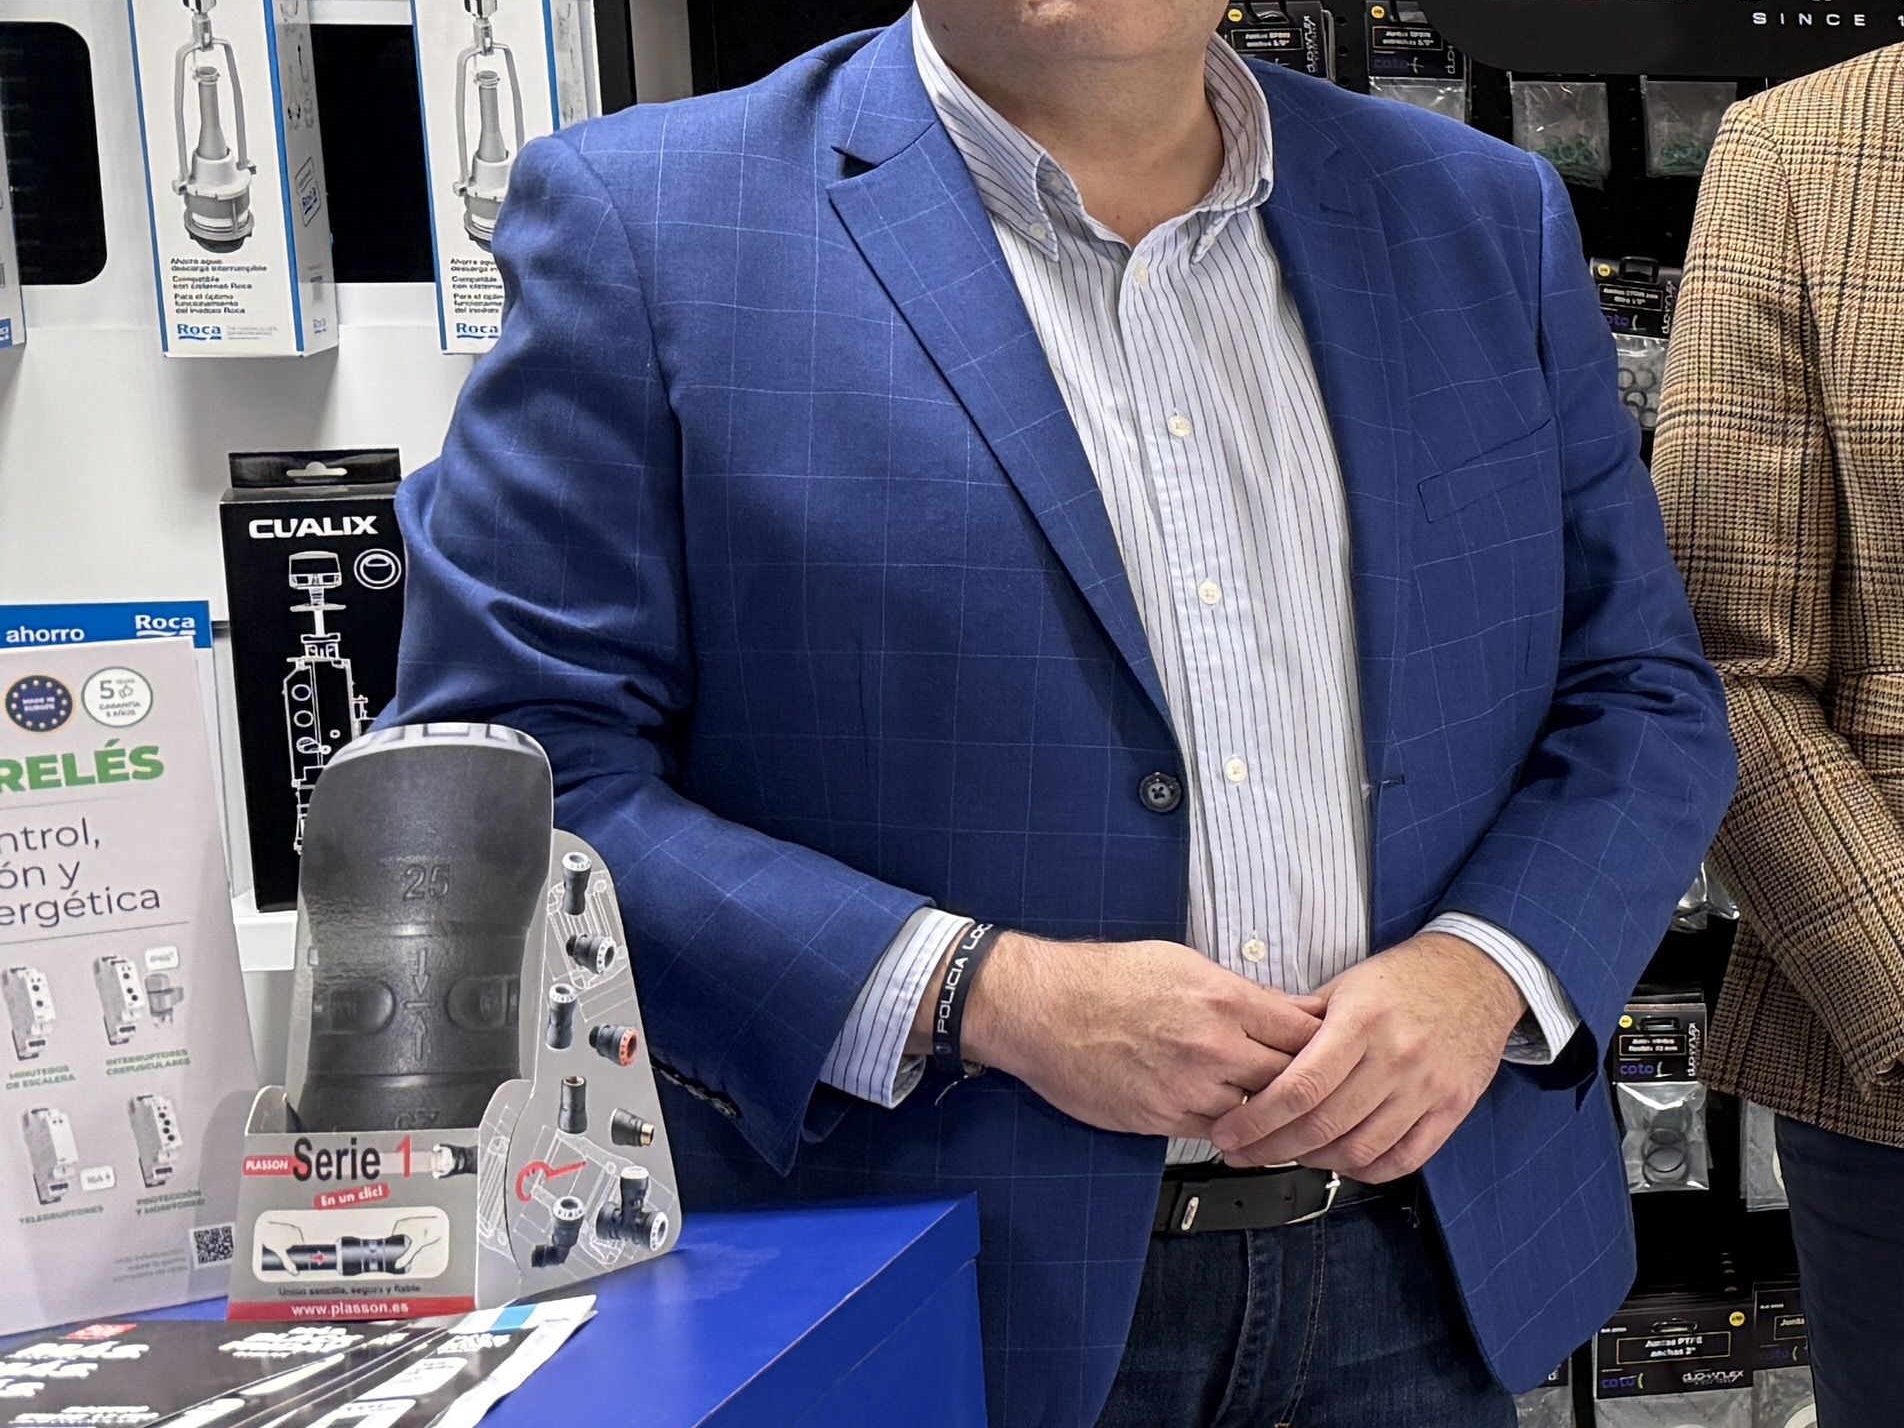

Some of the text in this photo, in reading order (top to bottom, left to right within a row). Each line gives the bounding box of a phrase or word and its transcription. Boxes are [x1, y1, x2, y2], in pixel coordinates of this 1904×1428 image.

[1753, 12, 1867, 28] SINCE
[176, 324, 222, 335] Roca
[456, 323, 499, 333] Roca
[248, 515, 379, 539] CUALIX
[6, 614, 196, 643] ahorro Roca
[99, 680, 115, 699] 5
[0, 738, 164, 794] RELÉS
[0, 817, 100, 853] ntrol,
[0, 860, 80, 891] ón y
[403, 863, 450, 902] 25
[0, 886, 161, 928] ergética
[106, 1048, 188, 1066] INTERRUPTORES
[106, 1057, 191, 1076] CREPUSCULARES
[6, 1073, 76, 1090] DE ESCALERA
[246, 1135, 412, 1182] PLASSON Serie 1
[321, 1195, 336, 1207] En
[339, 1193, 354, 1205] un
[292, 1300, 409, 1317] www.plasson.es
[1780, 1318, 1806, 1327] Junta
[1645, 1338, 1677, 1348] Juntas
[1650, 1348, 1684, 1358] anchas
